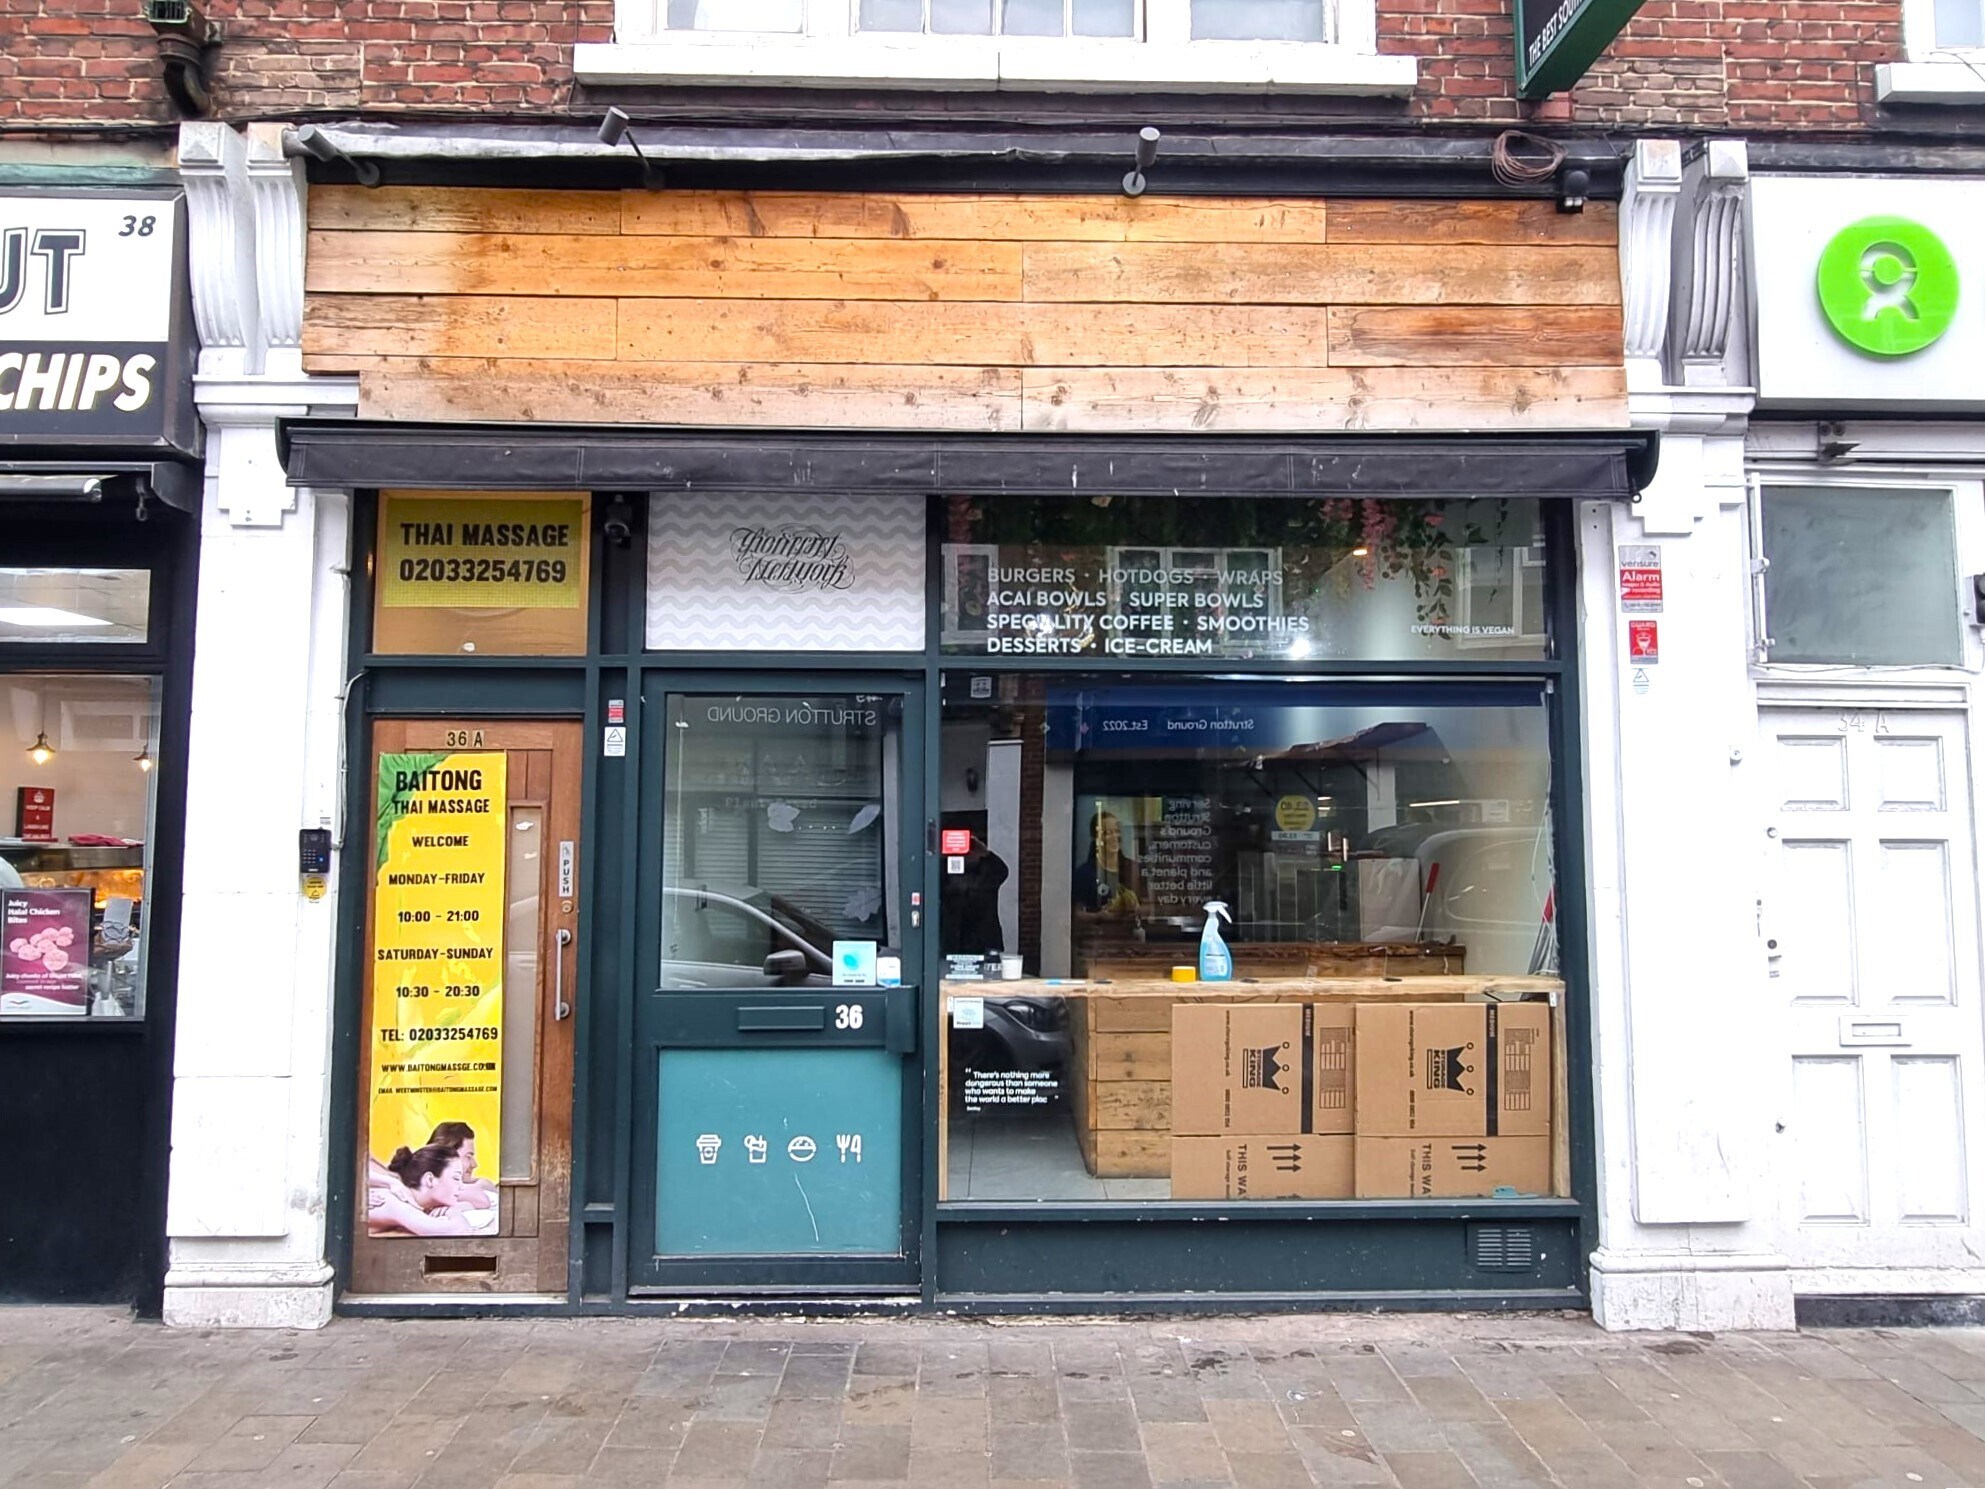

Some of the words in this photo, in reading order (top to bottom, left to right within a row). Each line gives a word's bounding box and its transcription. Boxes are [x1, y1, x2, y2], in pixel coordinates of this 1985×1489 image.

[1529, 34, 1541, 67] THE
[1542, 12, 1558, 51] BEST
[118, 215, 156, 237] 38
[0, 352, 156, 412] CHIPS
[400, 523, 453, 546] THAI
[462, 524, 569, 547] MASSAGE
[400, 558, 566, 583] 02033254769
[1621, 559, 1659, 567] verisure
[987, 568, 1076, 584] BURGERS
[1099, 569, 1194, 584] HOTDOGS
[1217, 570, 1283, 585] WRAPS
[1622, 570, 1660, 582] Alarm
[987, 590, 1031, 606] ACAI
[1037, 591, 1106, 607] BOWLS
[1129, 592, 1189, 608] SUPER
[1195, 592, 1264, 608] BOWLS
[1099, 614, 1174, 631] COFFEE
[1197, 615, 1310, 632] SMOOTHIES
[1411, 625, 1470, 634] EVERYTHING
[1472, 626, 1480, 634] IS
[1481, 626, 1515, 635] VEGAN
[987, 637, 1081, 653] DESSERTS
[1104, 638, 1212, 655] ICE-CREAM
[447, 731, 467, 746] 36
[474, 731, 484, 747] A
[396, 770, 482, 792] BAITONG
[393, 800, 423, 814] THAI
[428, 799, 490, 814] MASSAGE
[412, 836, 469, 847] WELCOME
[8, 900, 28, 908] Juicy
[398, 911, 431, 922] 10:00
[446, 910, 479, 922] 21:00
[396, 986, 429, 998] 10:30
[445, 985, 480, 998] 20:30
[835, 1004, 863, 1029] 36
[381, 1029, 404, 1041] TEL:
[409, 1027, 498, 1041] 02033254769
[965, 1080, 1004, 1088] dangerous
[973, 1071, 999, 1079] There's
[1001, 1071, 1029, 1080] nothing
[1237, 1144, 1247, 1172] THIS
[1422, 1143, 1431, 1171] THIS
[1237, 1175, 1247, 1199] WA
[1422, 1175, 1431, 1198] WA
